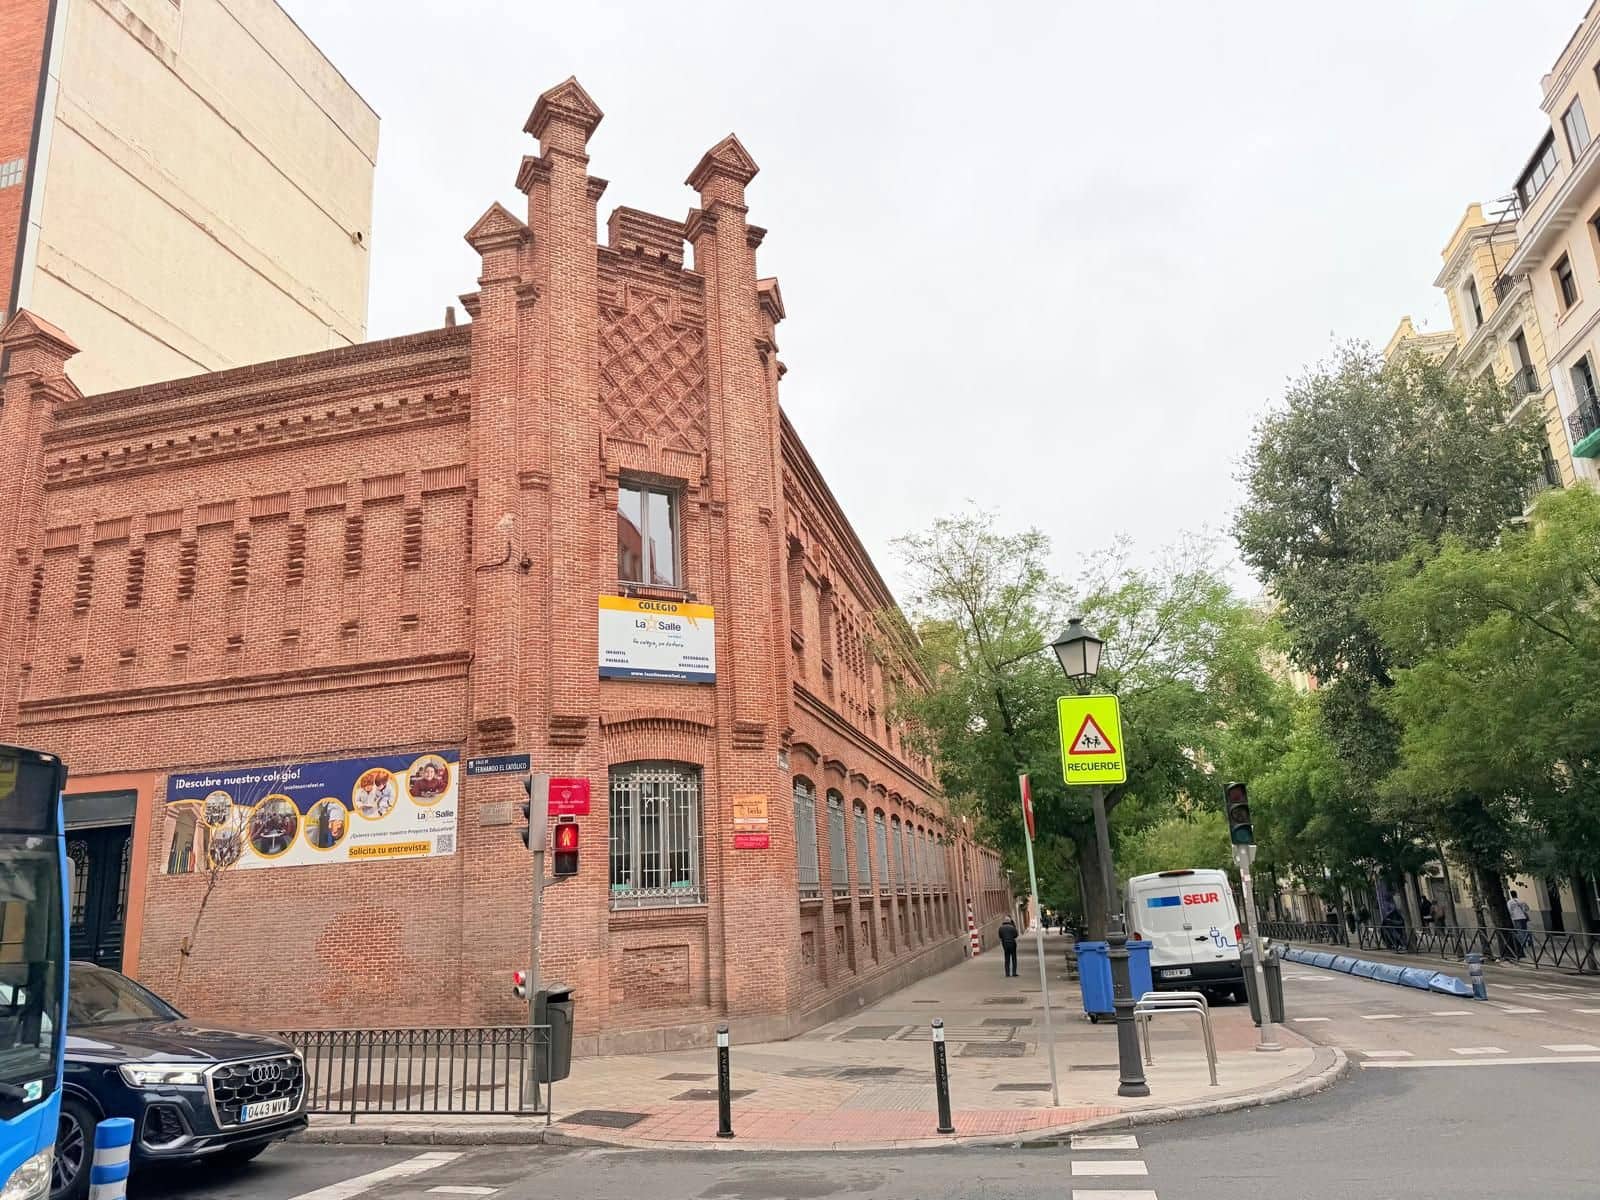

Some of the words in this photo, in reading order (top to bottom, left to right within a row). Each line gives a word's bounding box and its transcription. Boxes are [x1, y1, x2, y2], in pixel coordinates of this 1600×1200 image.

[638, 601, 678, 612] COLEGIO
[635, 619, 646, 629] La
[658, 620, 681, 632] Salle
[475, 764, 499, 774] FERNANDO
[1067, 761, 1121, 772] RECUERDE
[175, 775, 221, 790] ¡Descubre
[223, 774, 261, 786] nuestro
[417, 812, 426, 820] La
[435, 810, 454, 818] Salle
[348, 846, 377, 856] Solicita
[1183, 892, 1220, 905] SEUR
[248, 1103, 270, 1118] 0443
